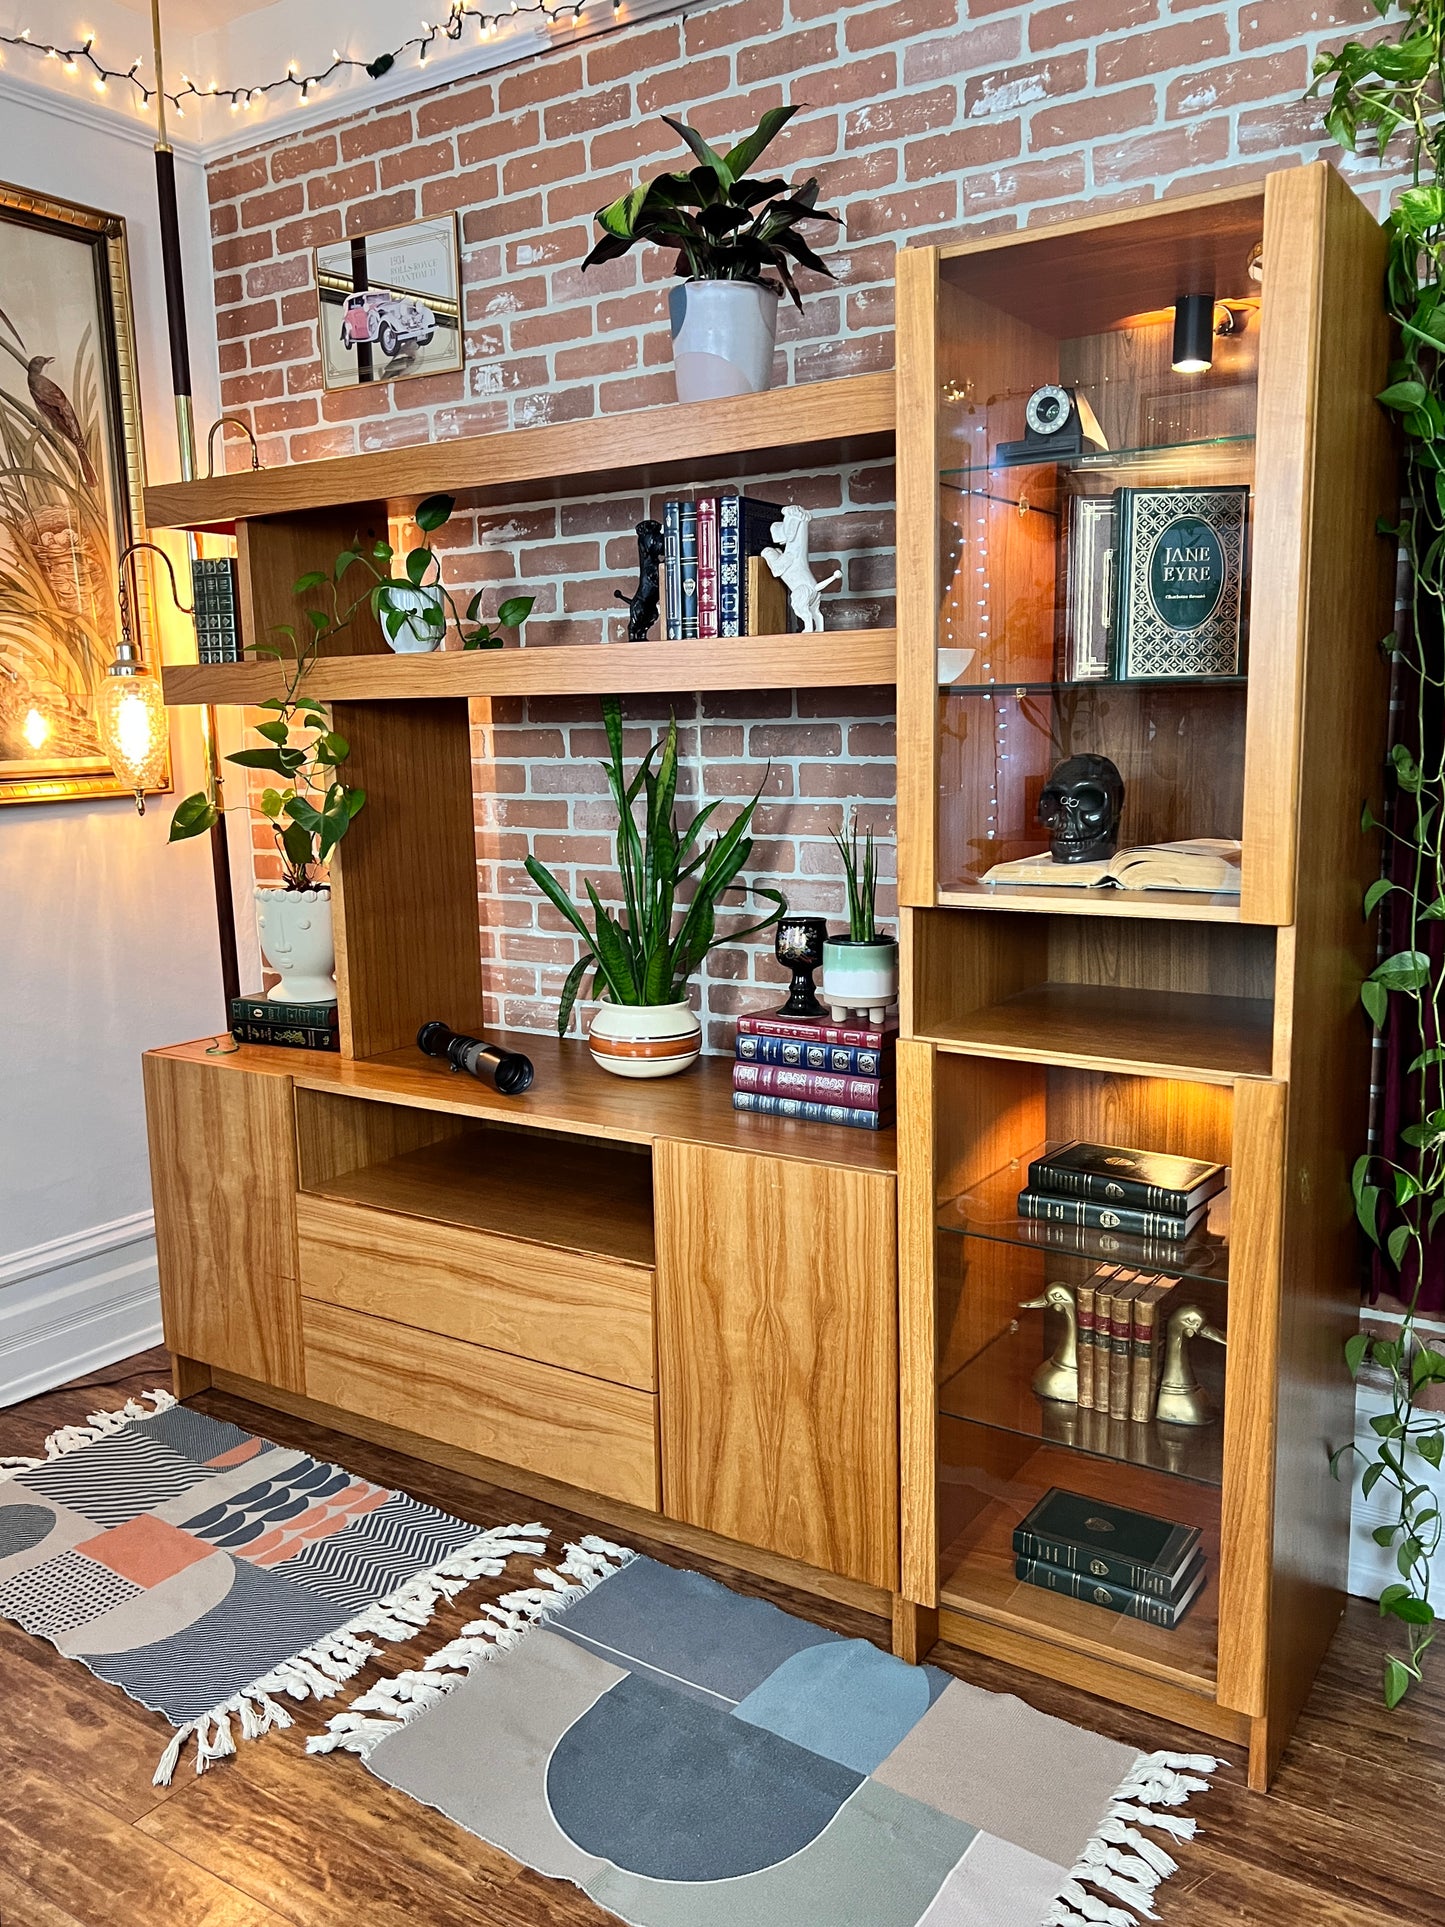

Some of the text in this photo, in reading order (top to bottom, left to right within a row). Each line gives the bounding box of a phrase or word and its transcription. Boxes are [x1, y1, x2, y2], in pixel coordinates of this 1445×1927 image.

[390, 270, 427, 284] PHANTOM
[1163, 547, 1210, 566] JANE
[1163, 566, 1210, 583] EYRE
